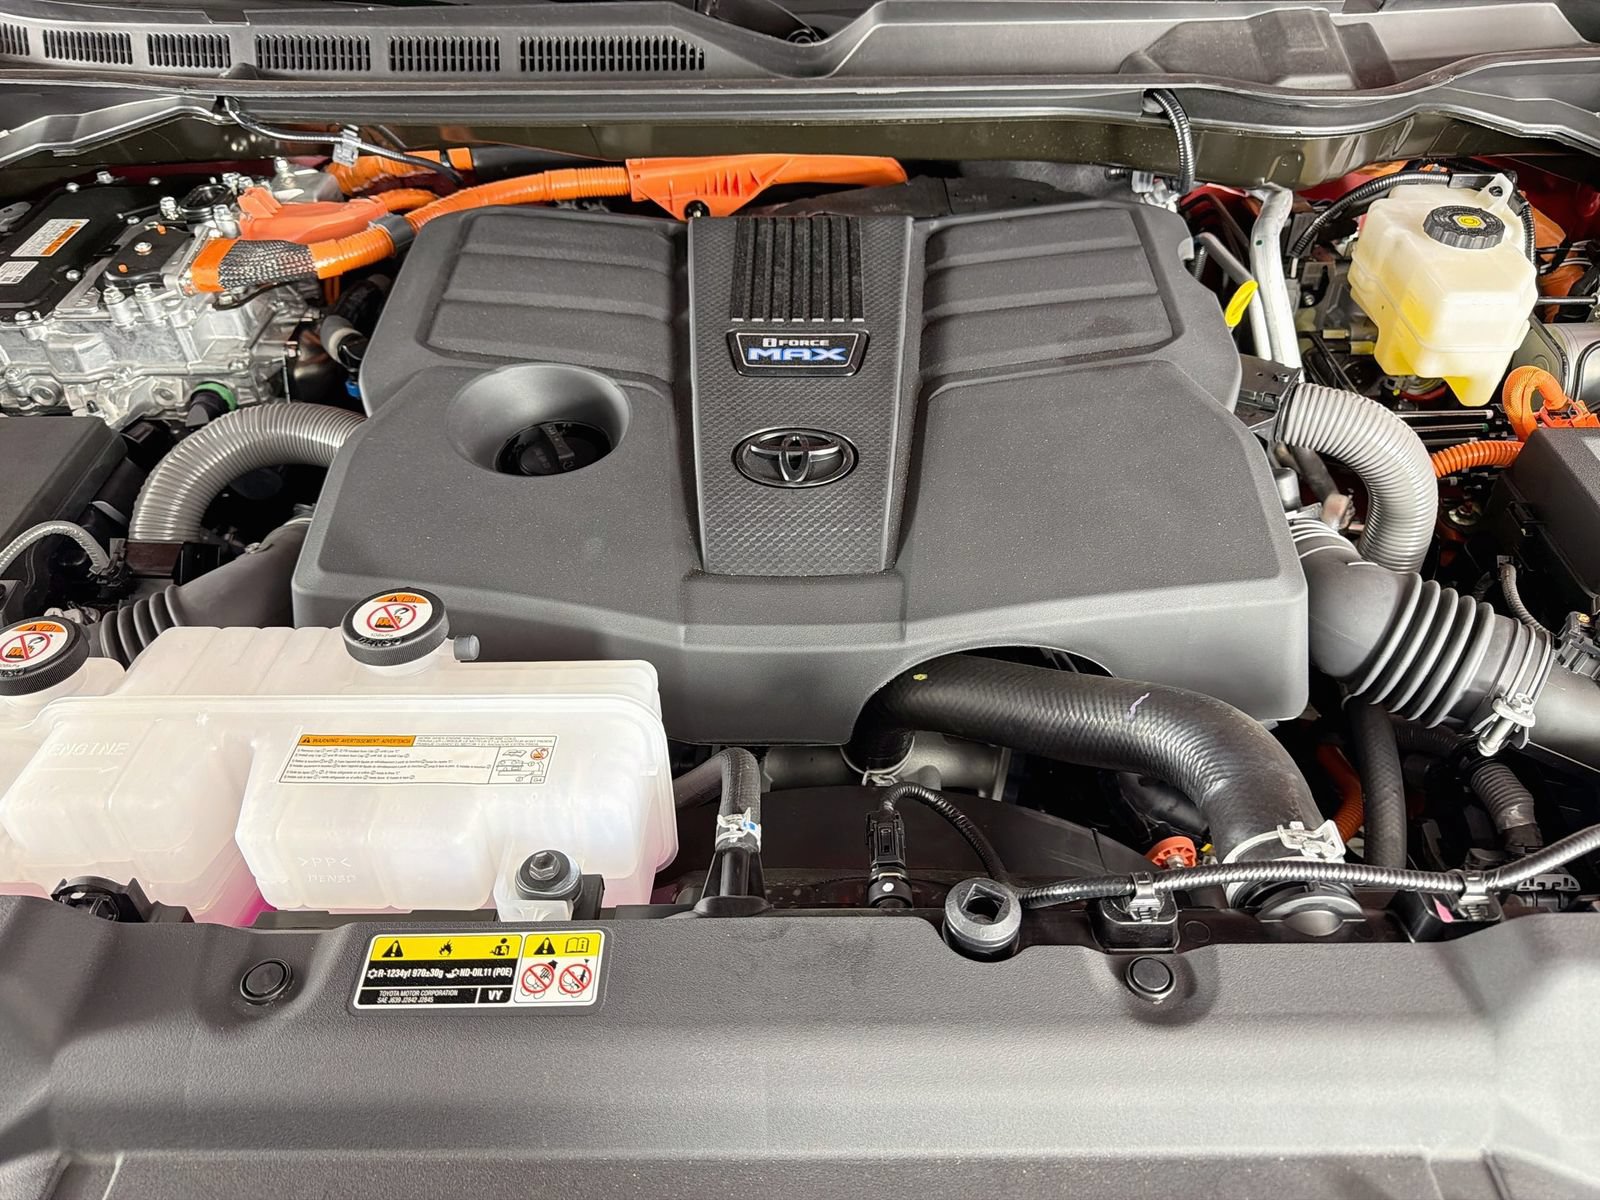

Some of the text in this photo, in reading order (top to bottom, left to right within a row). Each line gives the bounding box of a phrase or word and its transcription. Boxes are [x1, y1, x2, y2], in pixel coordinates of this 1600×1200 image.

[747, 347, 847, 361] MAX
[49, 742, 130, 756] ENGINE
[377, 967, 411, 978] R-1234yf
[459, 967, 491, 977] ND-OIL11
[492, 967, 513, 977] (POE)
[488, 990, 503, 1001] VY
